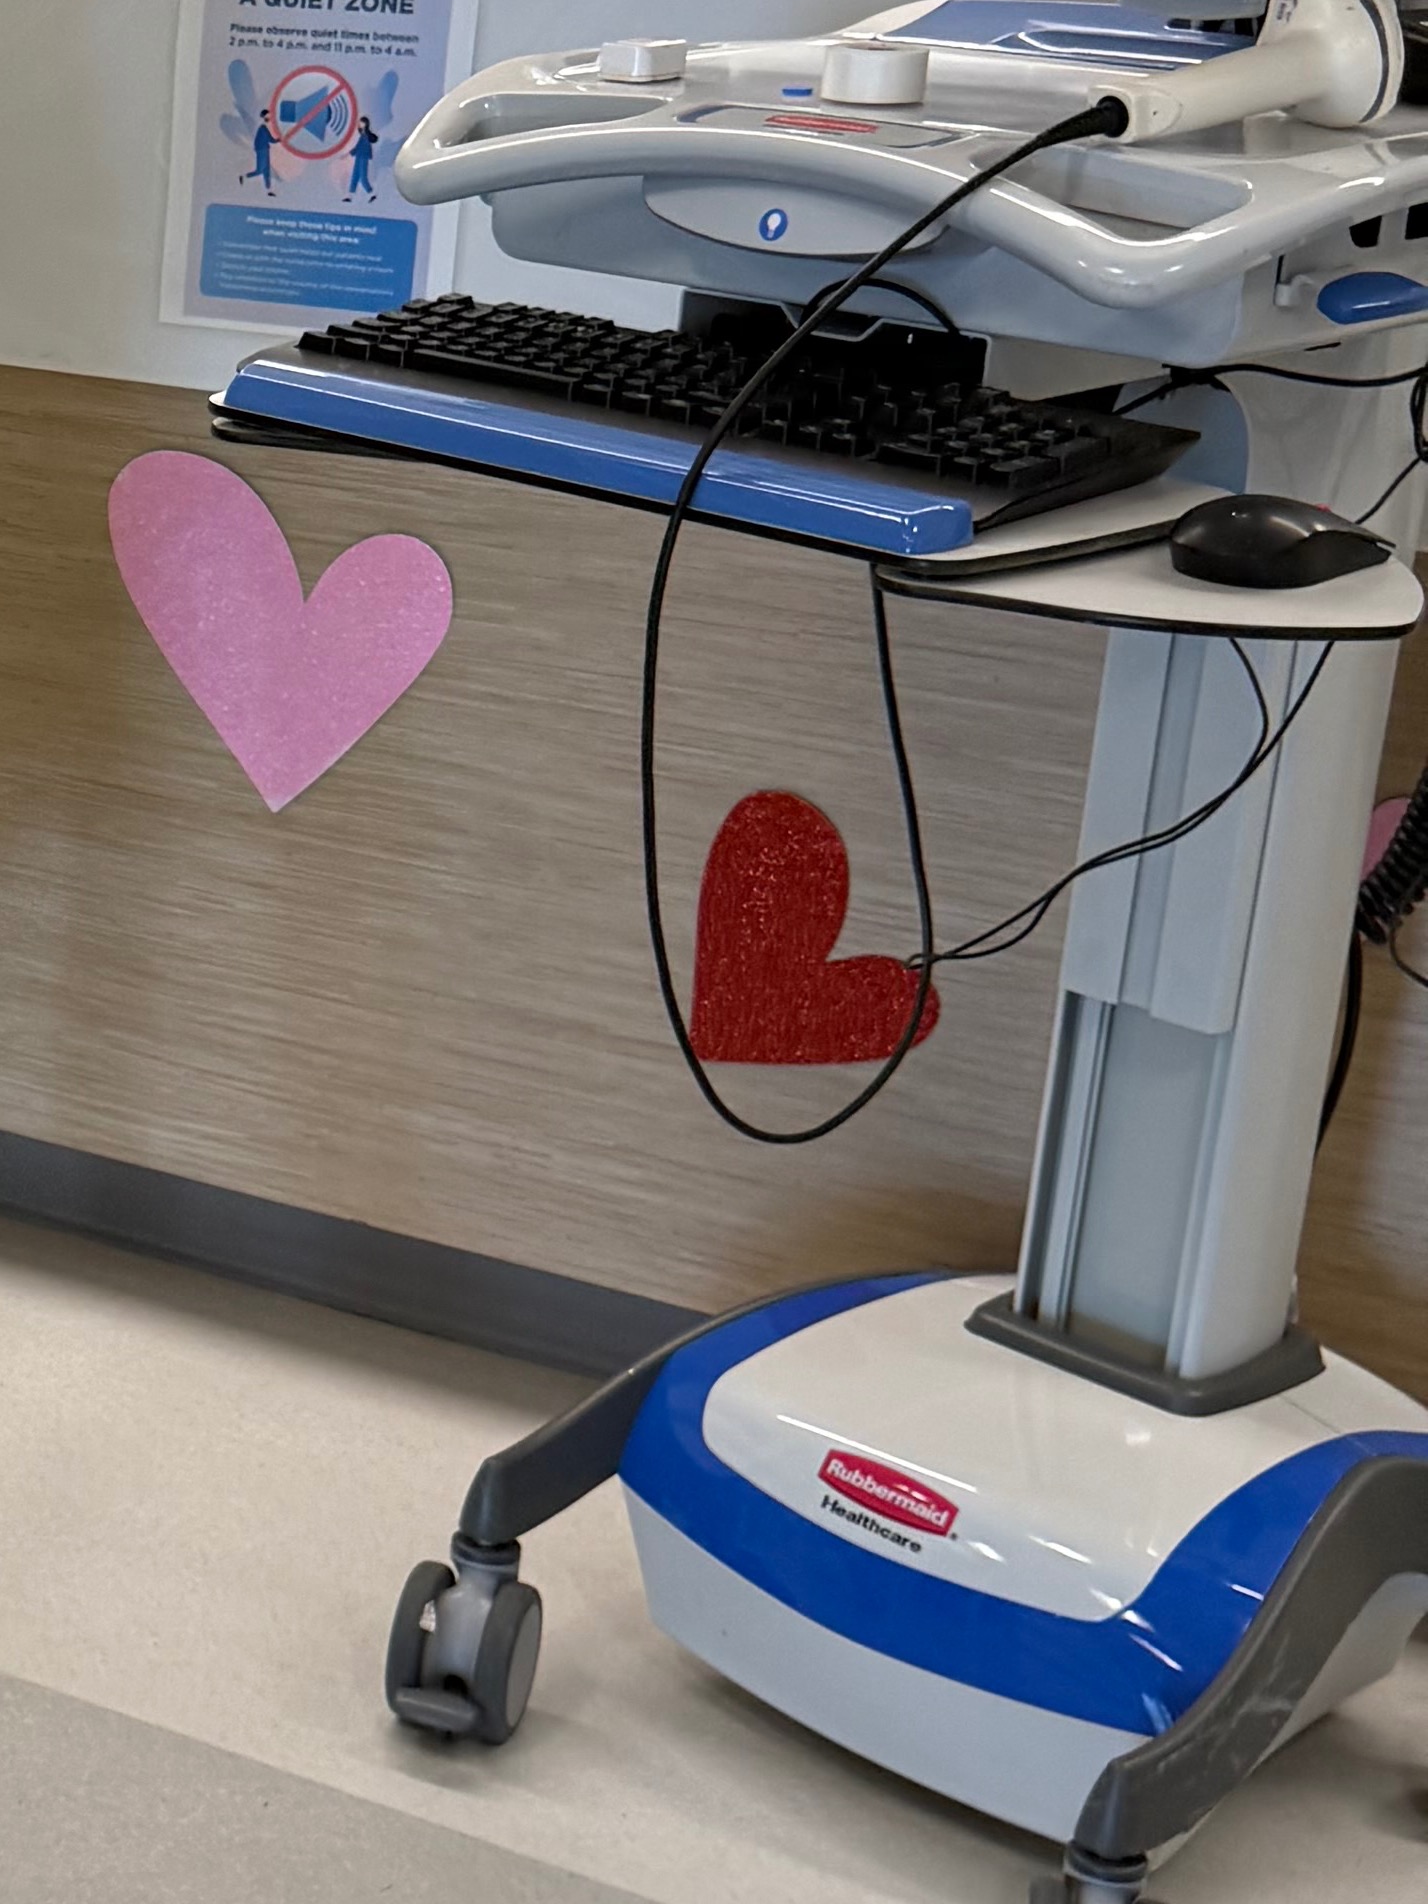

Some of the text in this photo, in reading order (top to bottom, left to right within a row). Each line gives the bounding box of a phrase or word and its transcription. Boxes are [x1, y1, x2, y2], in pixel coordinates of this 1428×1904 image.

[229, 36, 235, 46] 2
[238, 39, 259, 48] p.m.
[263, 39, 274, 48] to
[276, 39, 283, 48] 4
[286, 41, 307, 50] p.m.
[311, 42, 331, 52] and
[345, 45, 366, 54] p.m.
[371, 45, 382, 55] to
[385, 46, 392, 55] 4
[395, 48, 417, 57] a.m.
[230, 23, 419, 43] Please observe quiet times between
[826, 1458, 950, 1526] Rubbermaid
[821, 1495, 922, 1553] Healthcare
